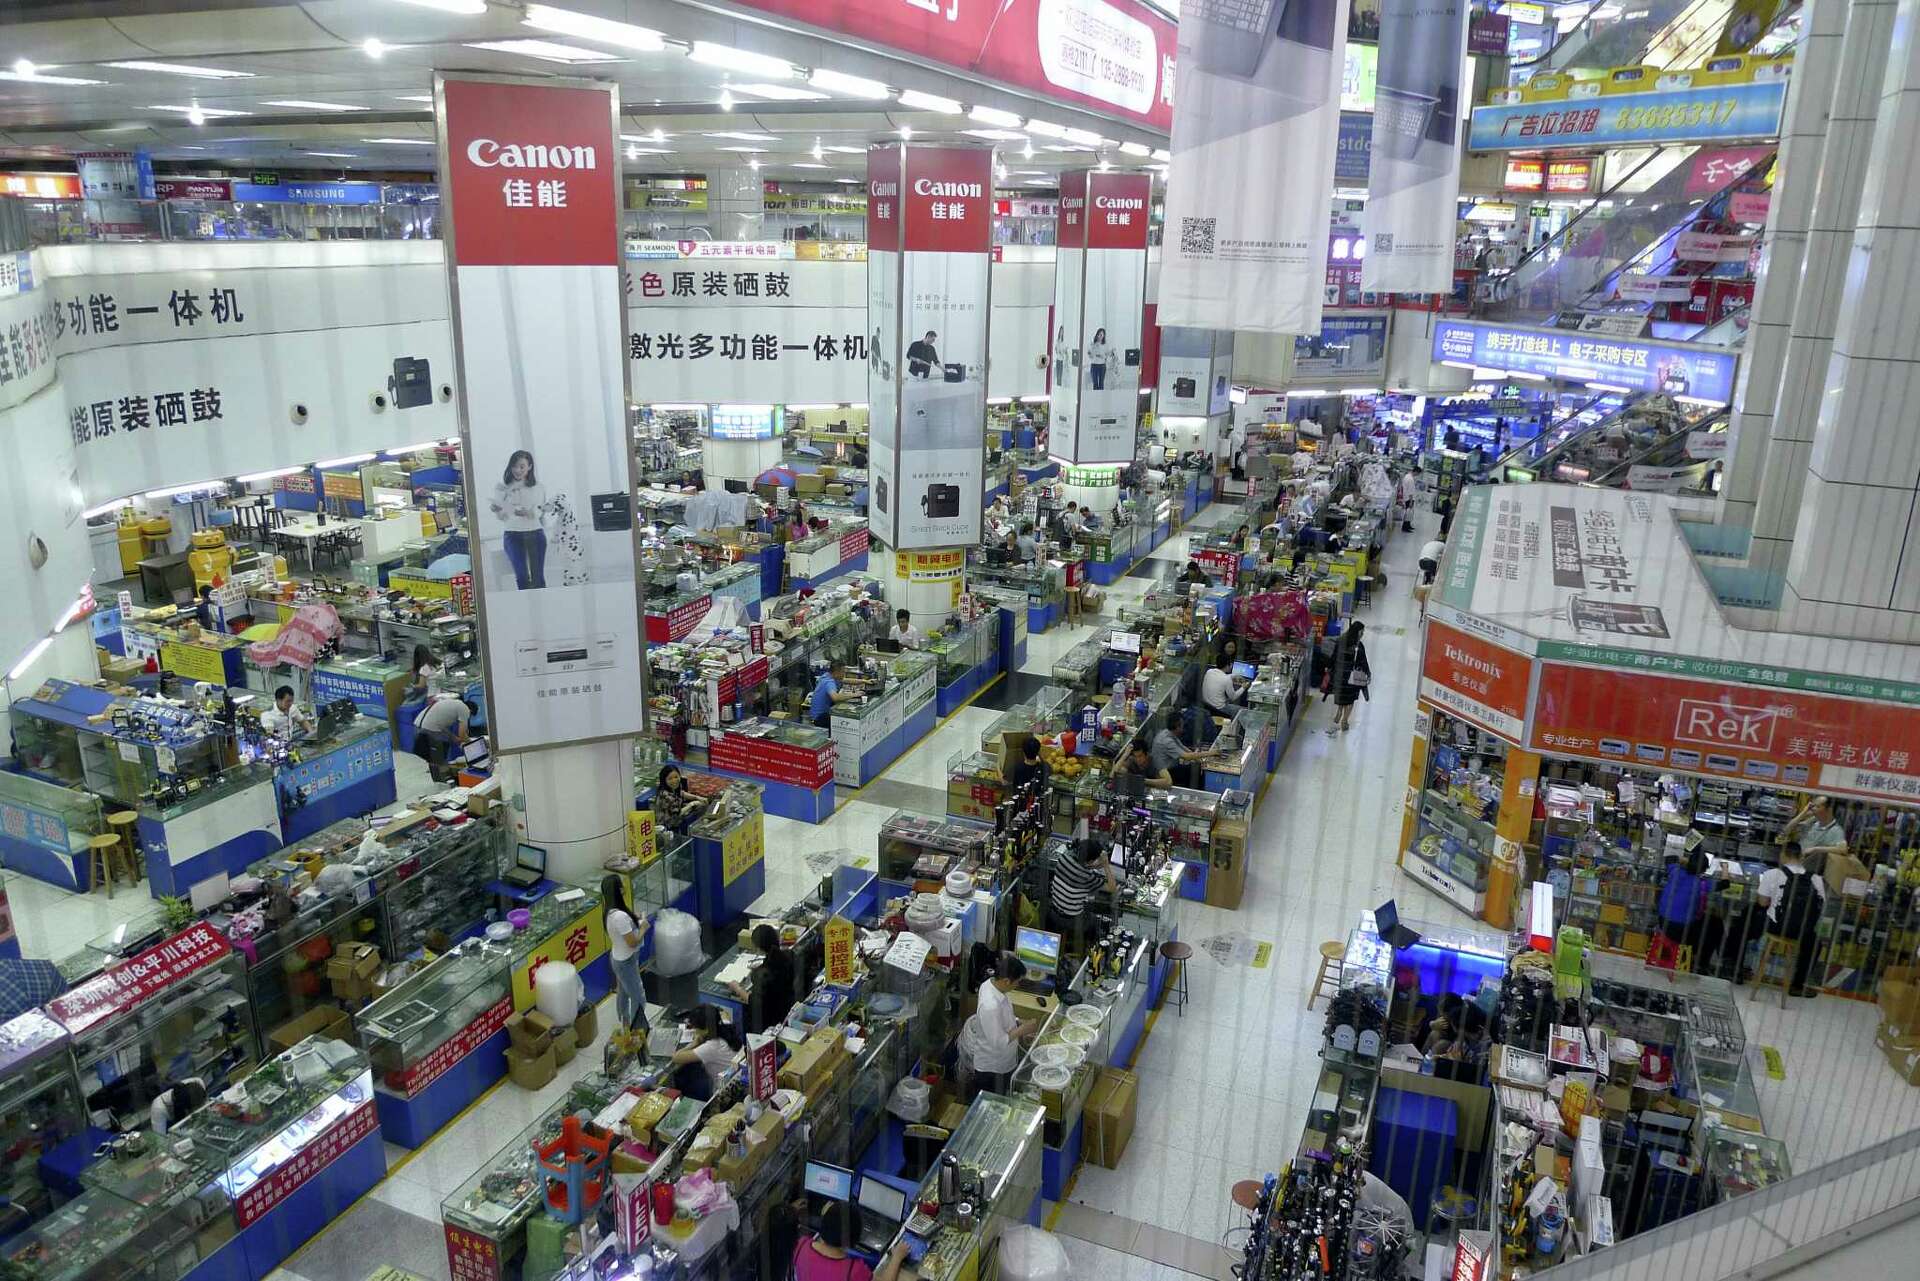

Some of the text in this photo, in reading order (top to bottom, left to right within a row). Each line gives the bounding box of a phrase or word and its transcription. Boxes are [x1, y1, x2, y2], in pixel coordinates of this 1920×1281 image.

[1501, 99, 1737, 137] 广告位招租 83685317
[467, 139, 597, 169] Canon
[186, 185, 223, 193] PANTUM
[287, 189, 345, 200] SAMSUNG
[502, 178, 568, 209] 佳能
[871, 180, 897, 197] Canon
[914, 178, 982, 198] Canon
[931, 201, 965, 220] 佳能
[1062, 196, 1083, 209] Canon
[1095, 195, 1143, 209] Canon
[1106, 212, 1131, 225] 佳能
[629, 332, 869, 361] 激光多功能一体机
[1569, 342, 1649, 368] 电子采购专区
[1444, 642, 1504, 679] Tektronix
[1688, 707, 1762, 744] Rek
[1542, 733, 1595, 750] 专业生产
[1786, 736, 1910, 770] 美瑞克仪器
[1855, 770, 1920, 796] 群豪仪器
[640, 820, 654, 857] 电容
[635, 1201, 649, 1246] LED
